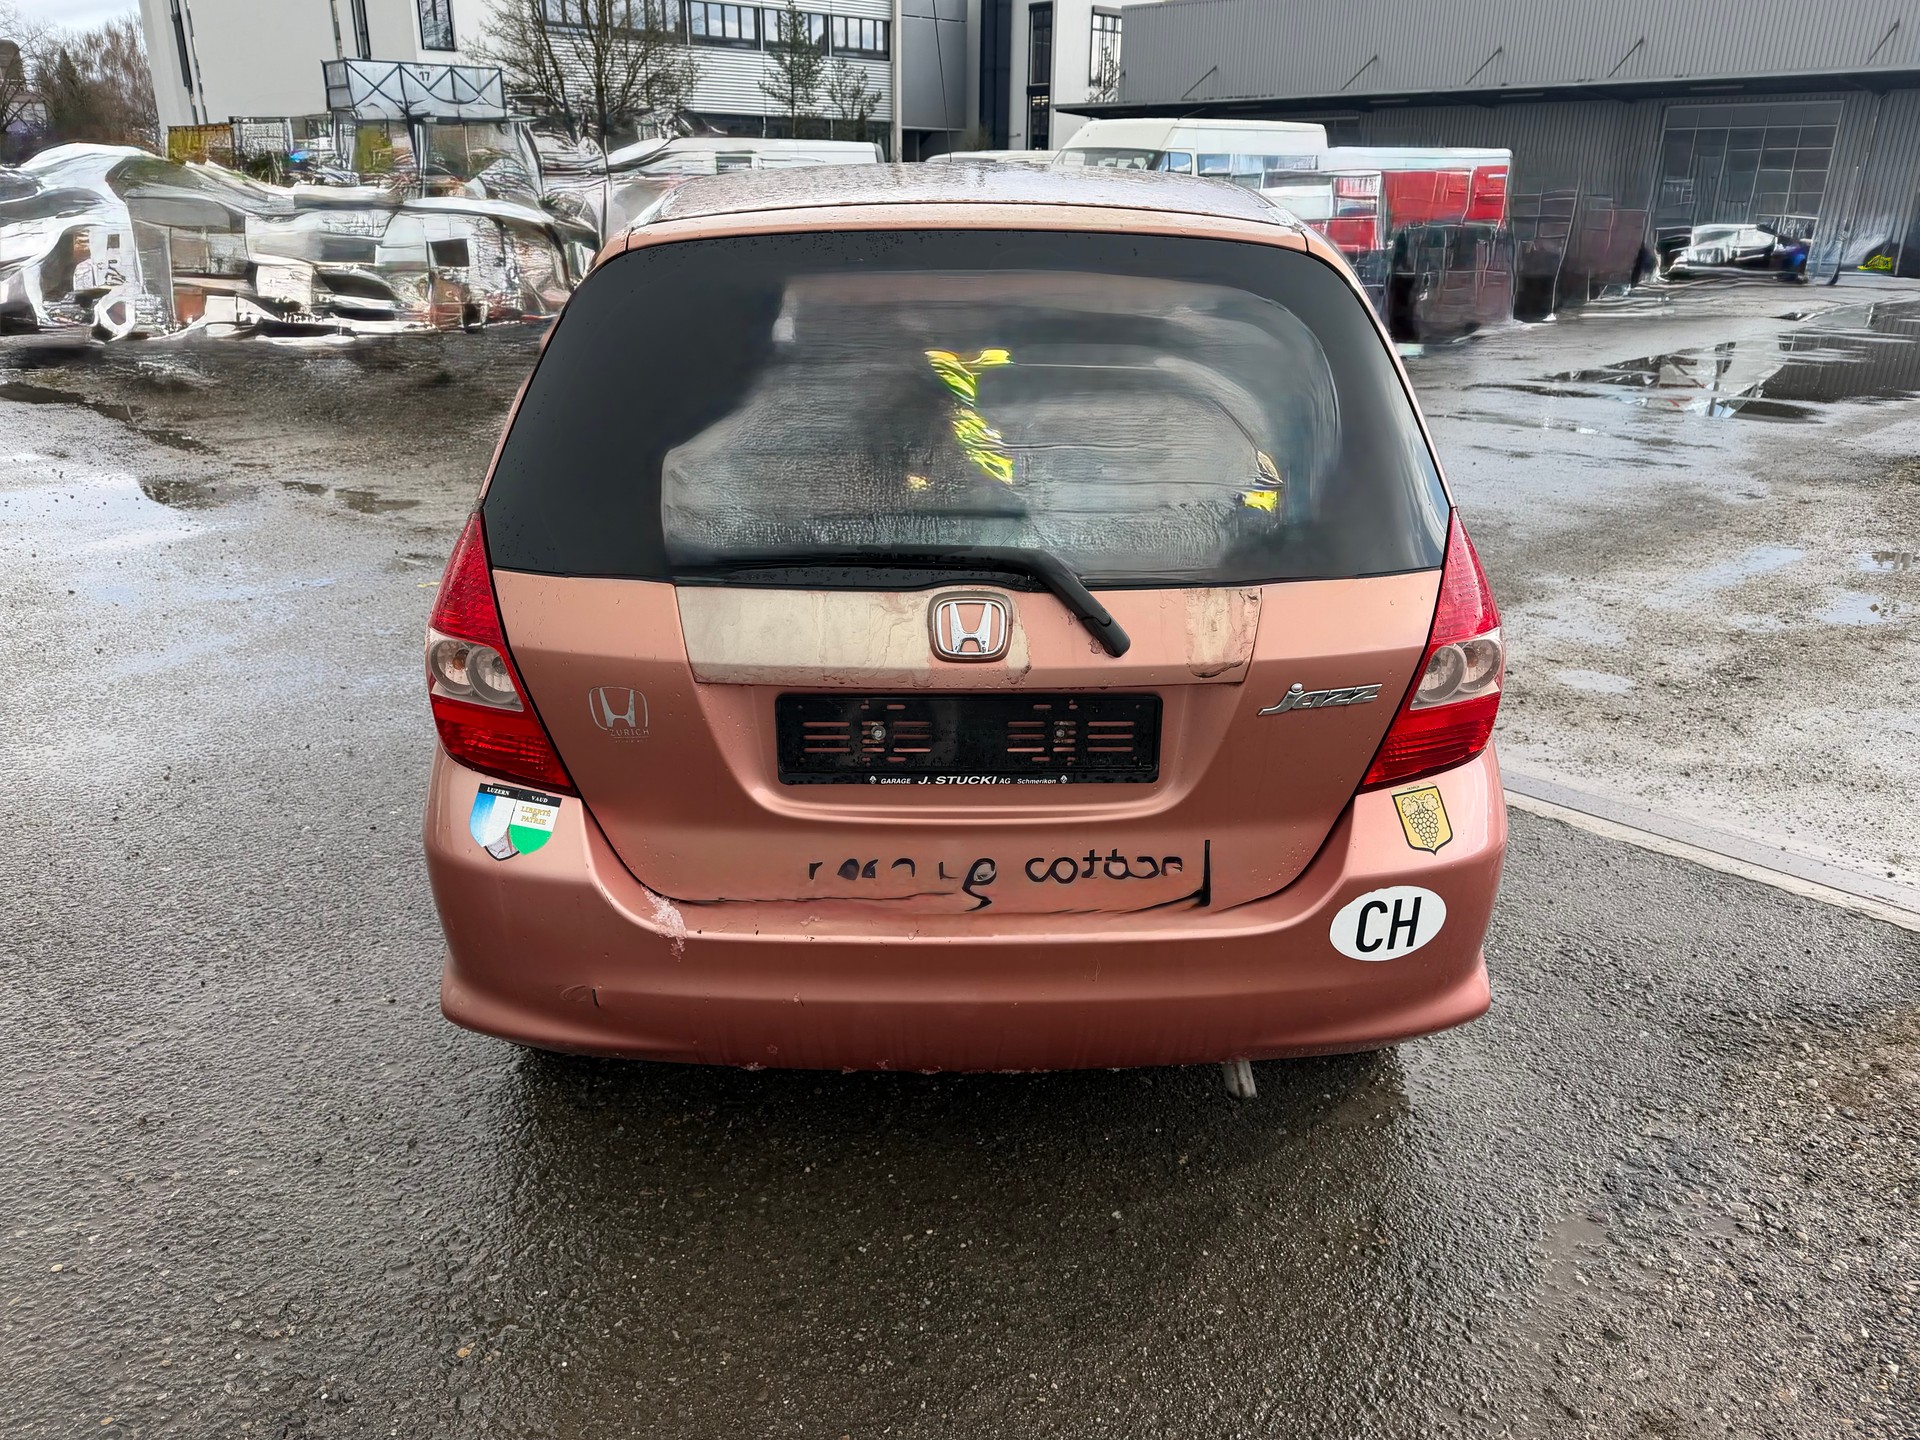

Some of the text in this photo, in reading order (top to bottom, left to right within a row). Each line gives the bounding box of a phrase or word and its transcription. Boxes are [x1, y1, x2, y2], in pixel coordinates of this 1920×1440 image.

[917, 775, 931, 785] J.
[935, 775, 998, 785] STUCKI
[998, 777, 1011, 785] AG
[486, 786, 511, 796] LUZERN
[531, 795, 549, 803] VAUD
[520, 815, 547, 826] PATRIE
[1355, 896, 1423, 953] CH
